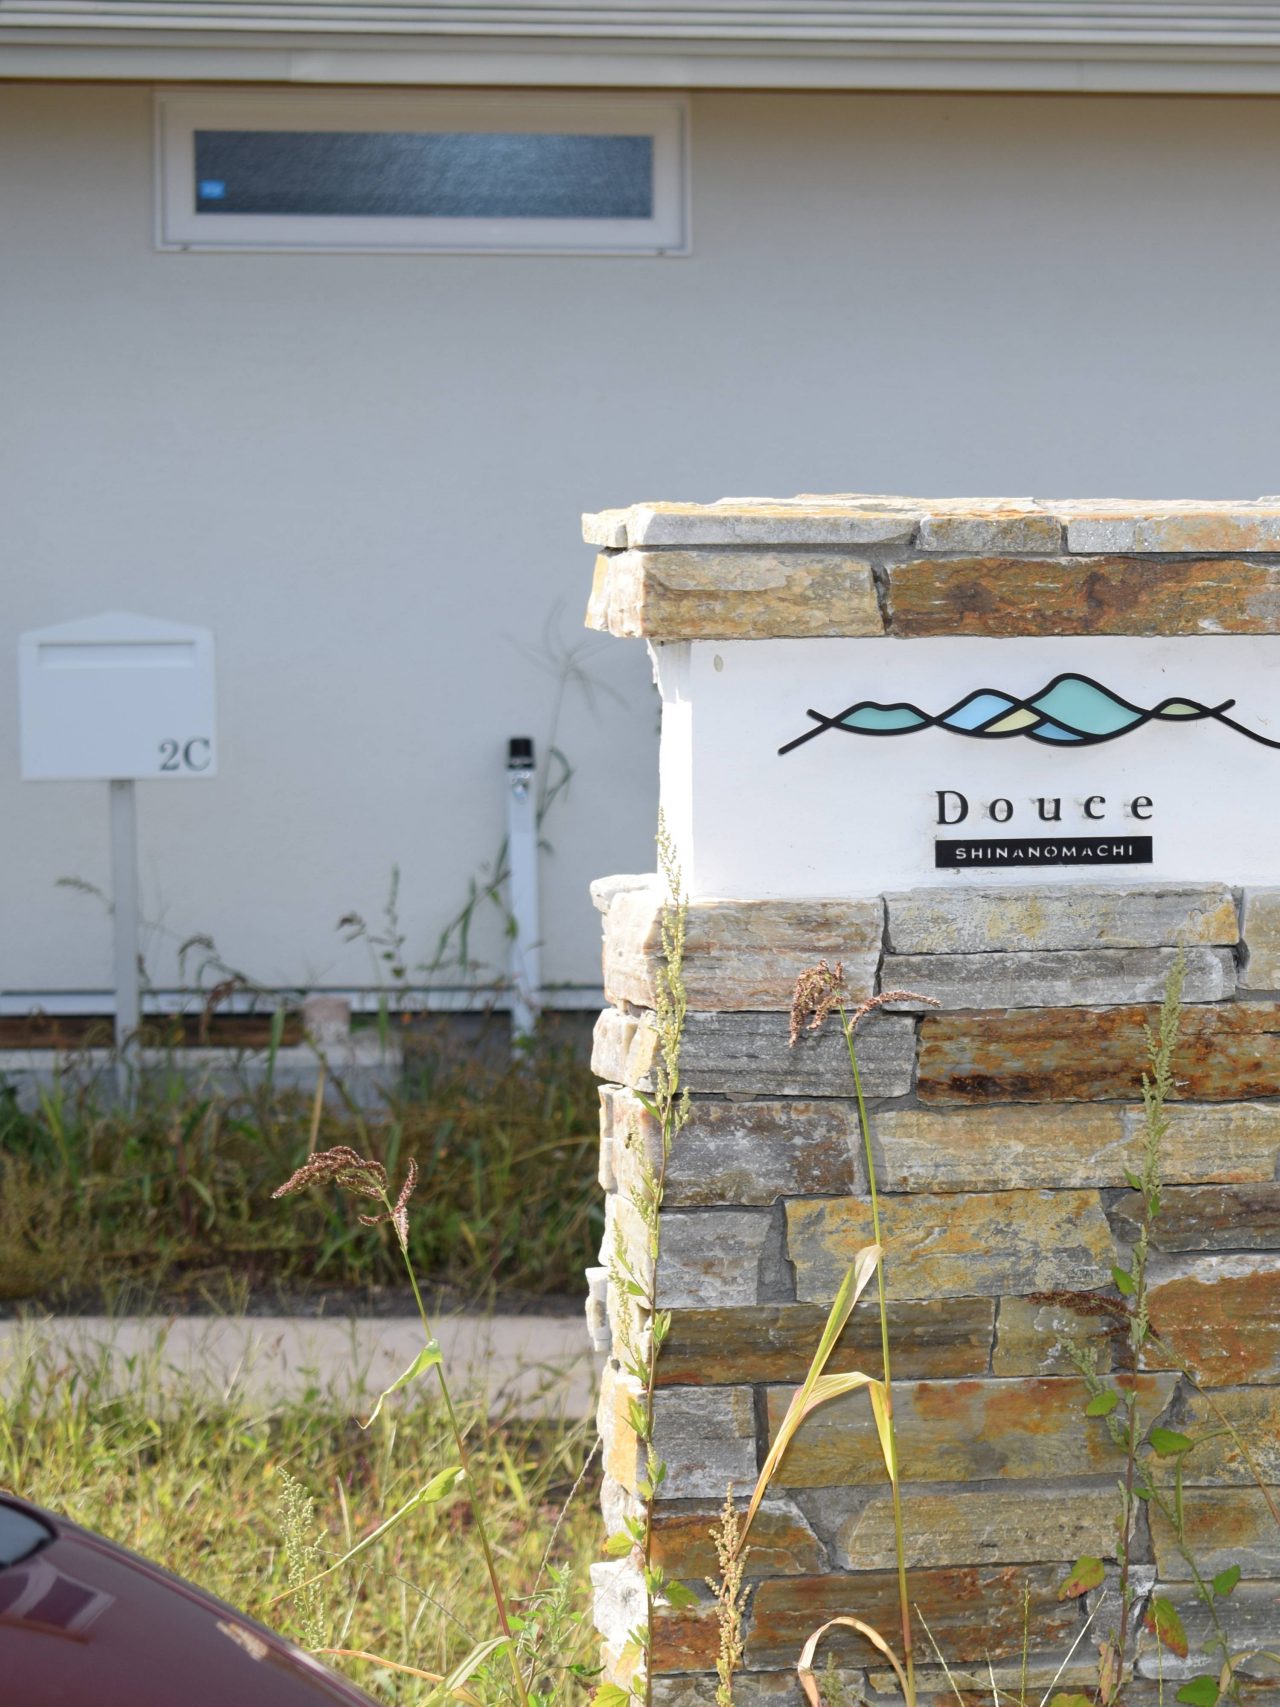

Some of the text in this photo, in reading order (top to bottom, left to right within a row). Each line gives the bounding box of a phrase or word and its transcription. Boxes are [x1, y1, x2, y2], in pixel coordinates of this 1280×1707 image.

[158, 736, 211, 771] 2C
[935, 790, 1153, 825] Douce
[955, 844, 1133, 860] SHINANOMACHI
